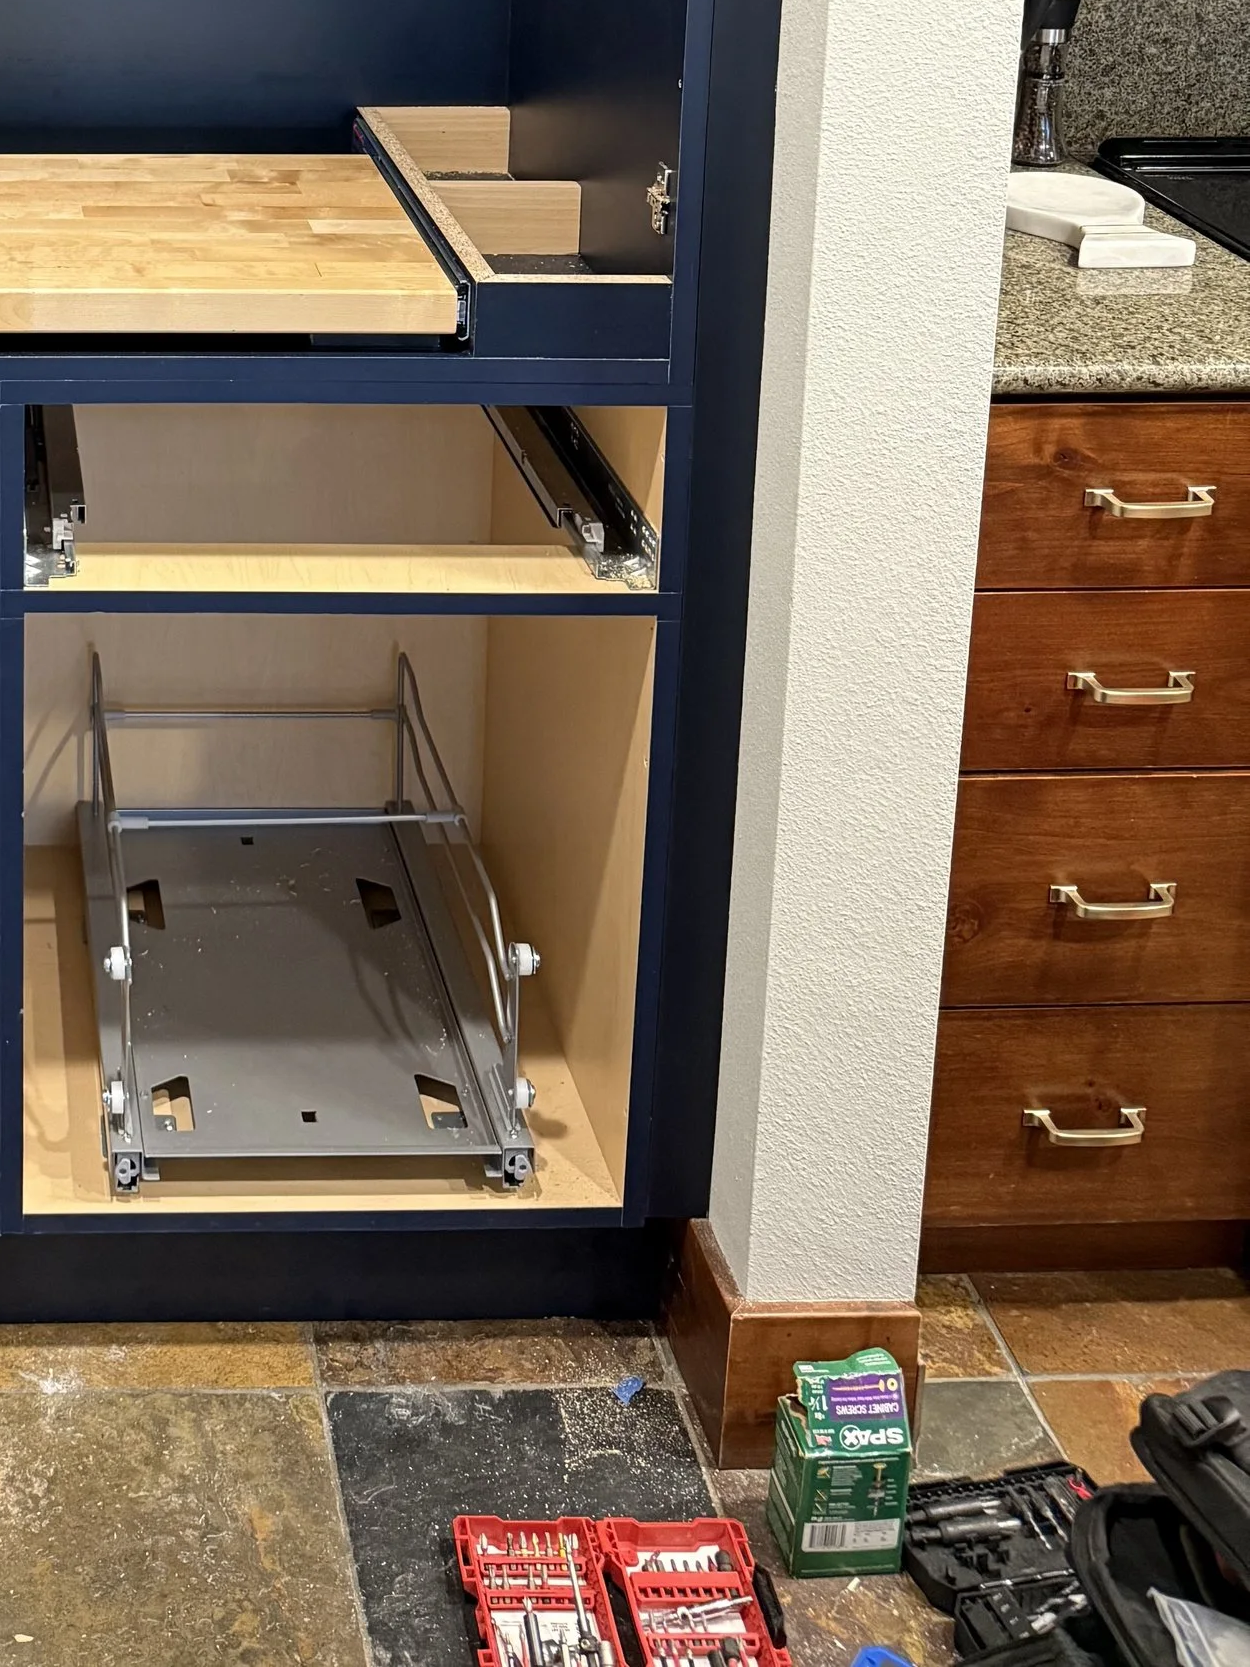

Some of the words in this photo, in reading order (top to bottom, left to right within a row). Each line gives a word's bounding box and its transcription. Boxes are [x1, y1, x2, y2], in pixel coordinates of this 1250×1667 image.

[835, 1403, 867, 1415] SCREWS
[868, 1402, 900, 1414] CABINET
[840, 1426, 904, 1448] SPAX
